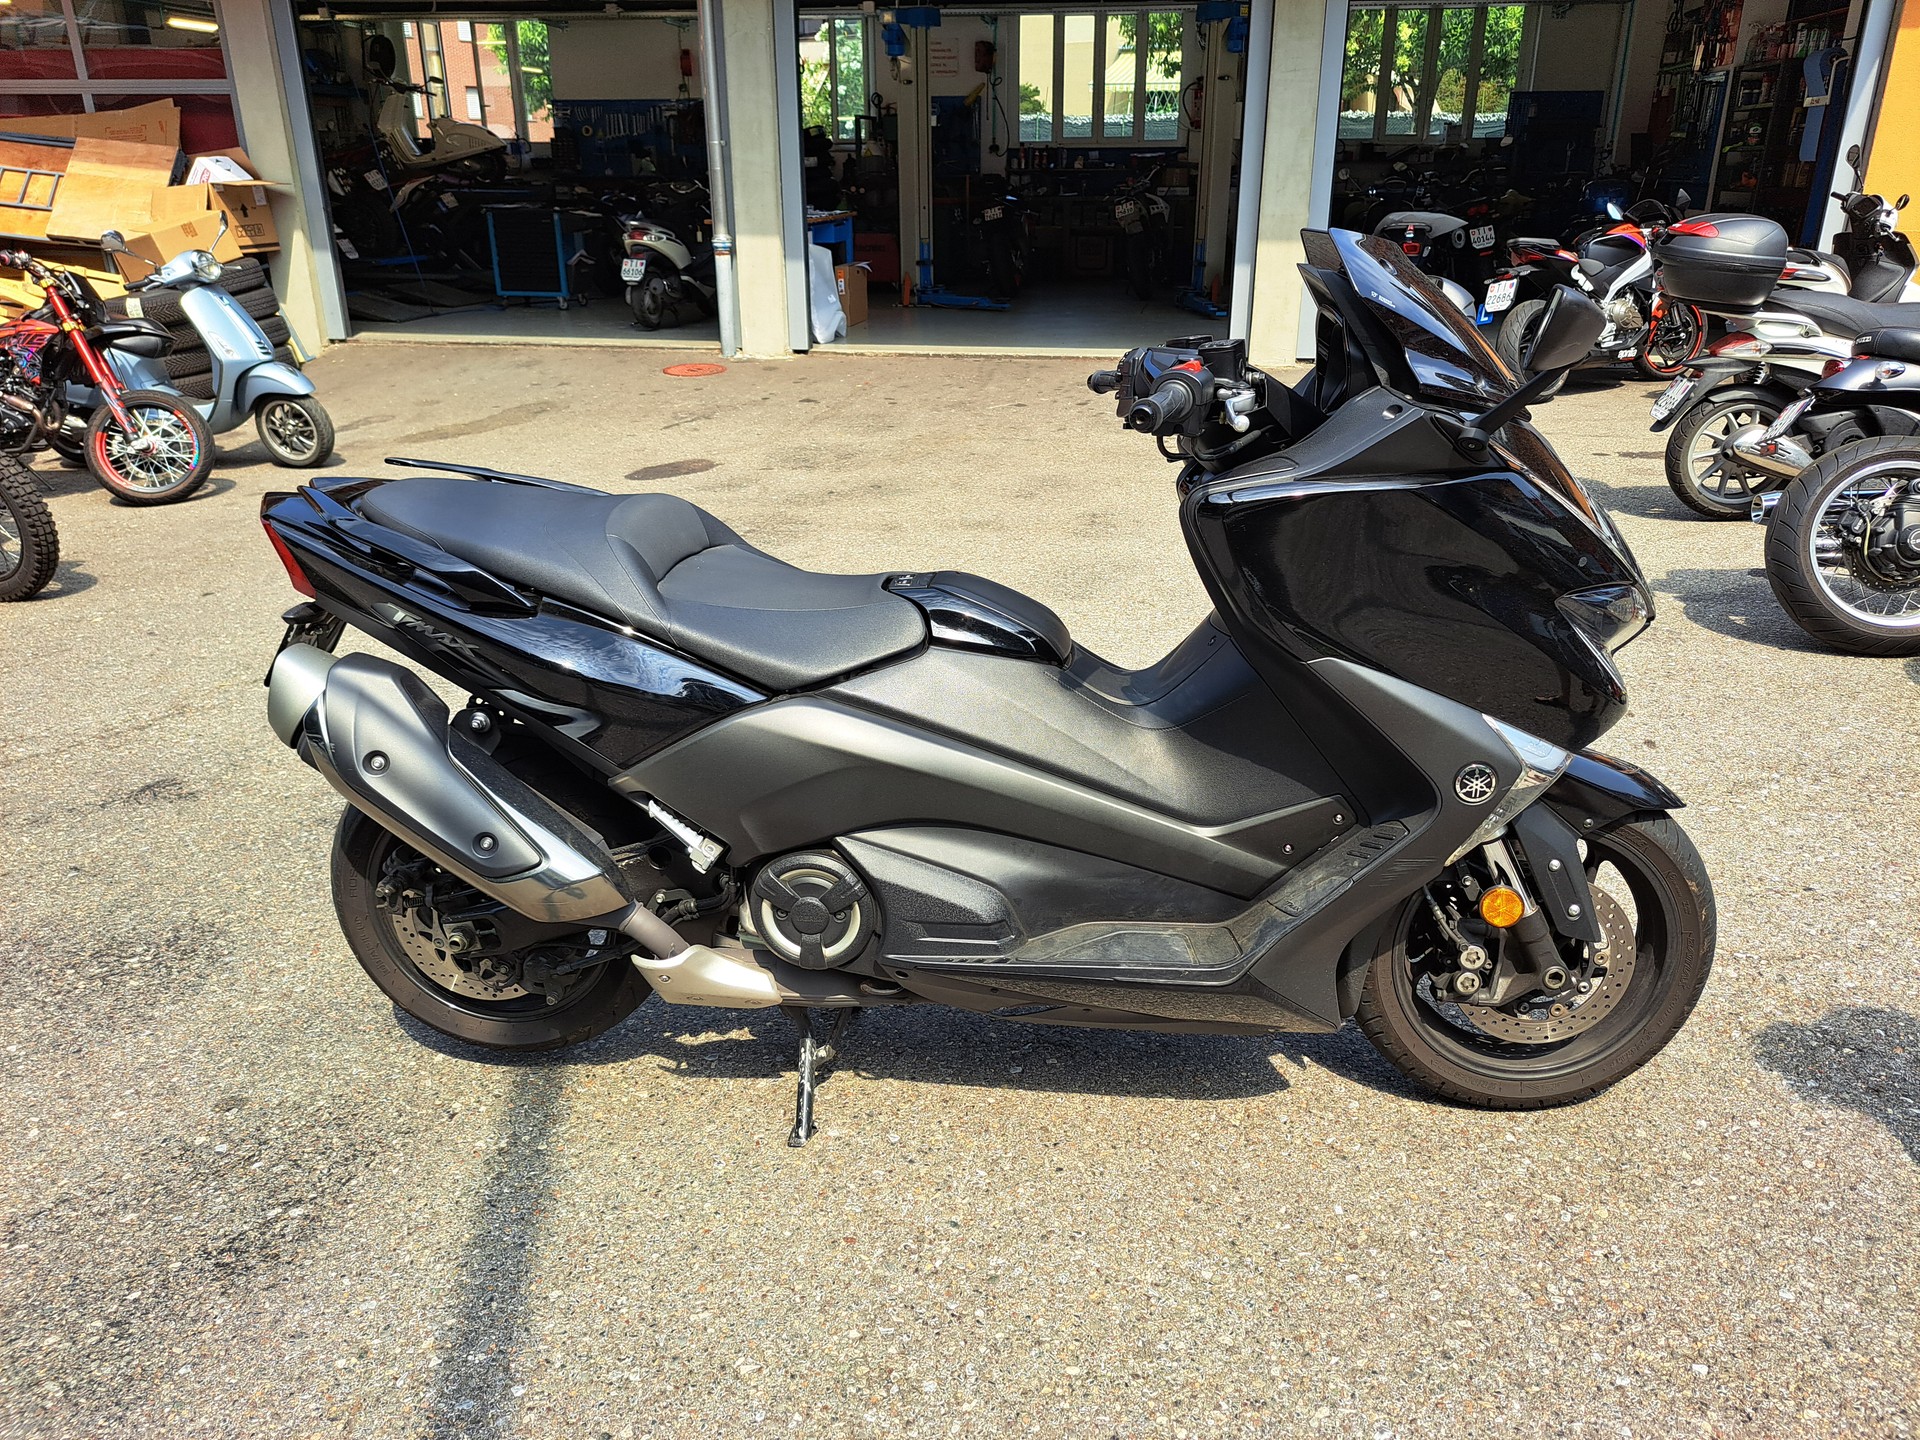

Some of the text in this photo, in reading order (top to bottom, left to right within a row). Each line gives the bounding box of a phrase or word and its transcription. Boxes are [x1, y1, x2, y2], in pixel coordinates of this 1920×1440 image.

[1472, 233, 1494, 244] 40144
[623, 267, 643, 276] 66106
[1497, 282, 1507, 293] TI
[1486, 291, 1512, 305] 22686
[1480, 306, 1489, 322] L
[389, 604, 479, 658] TMAX
